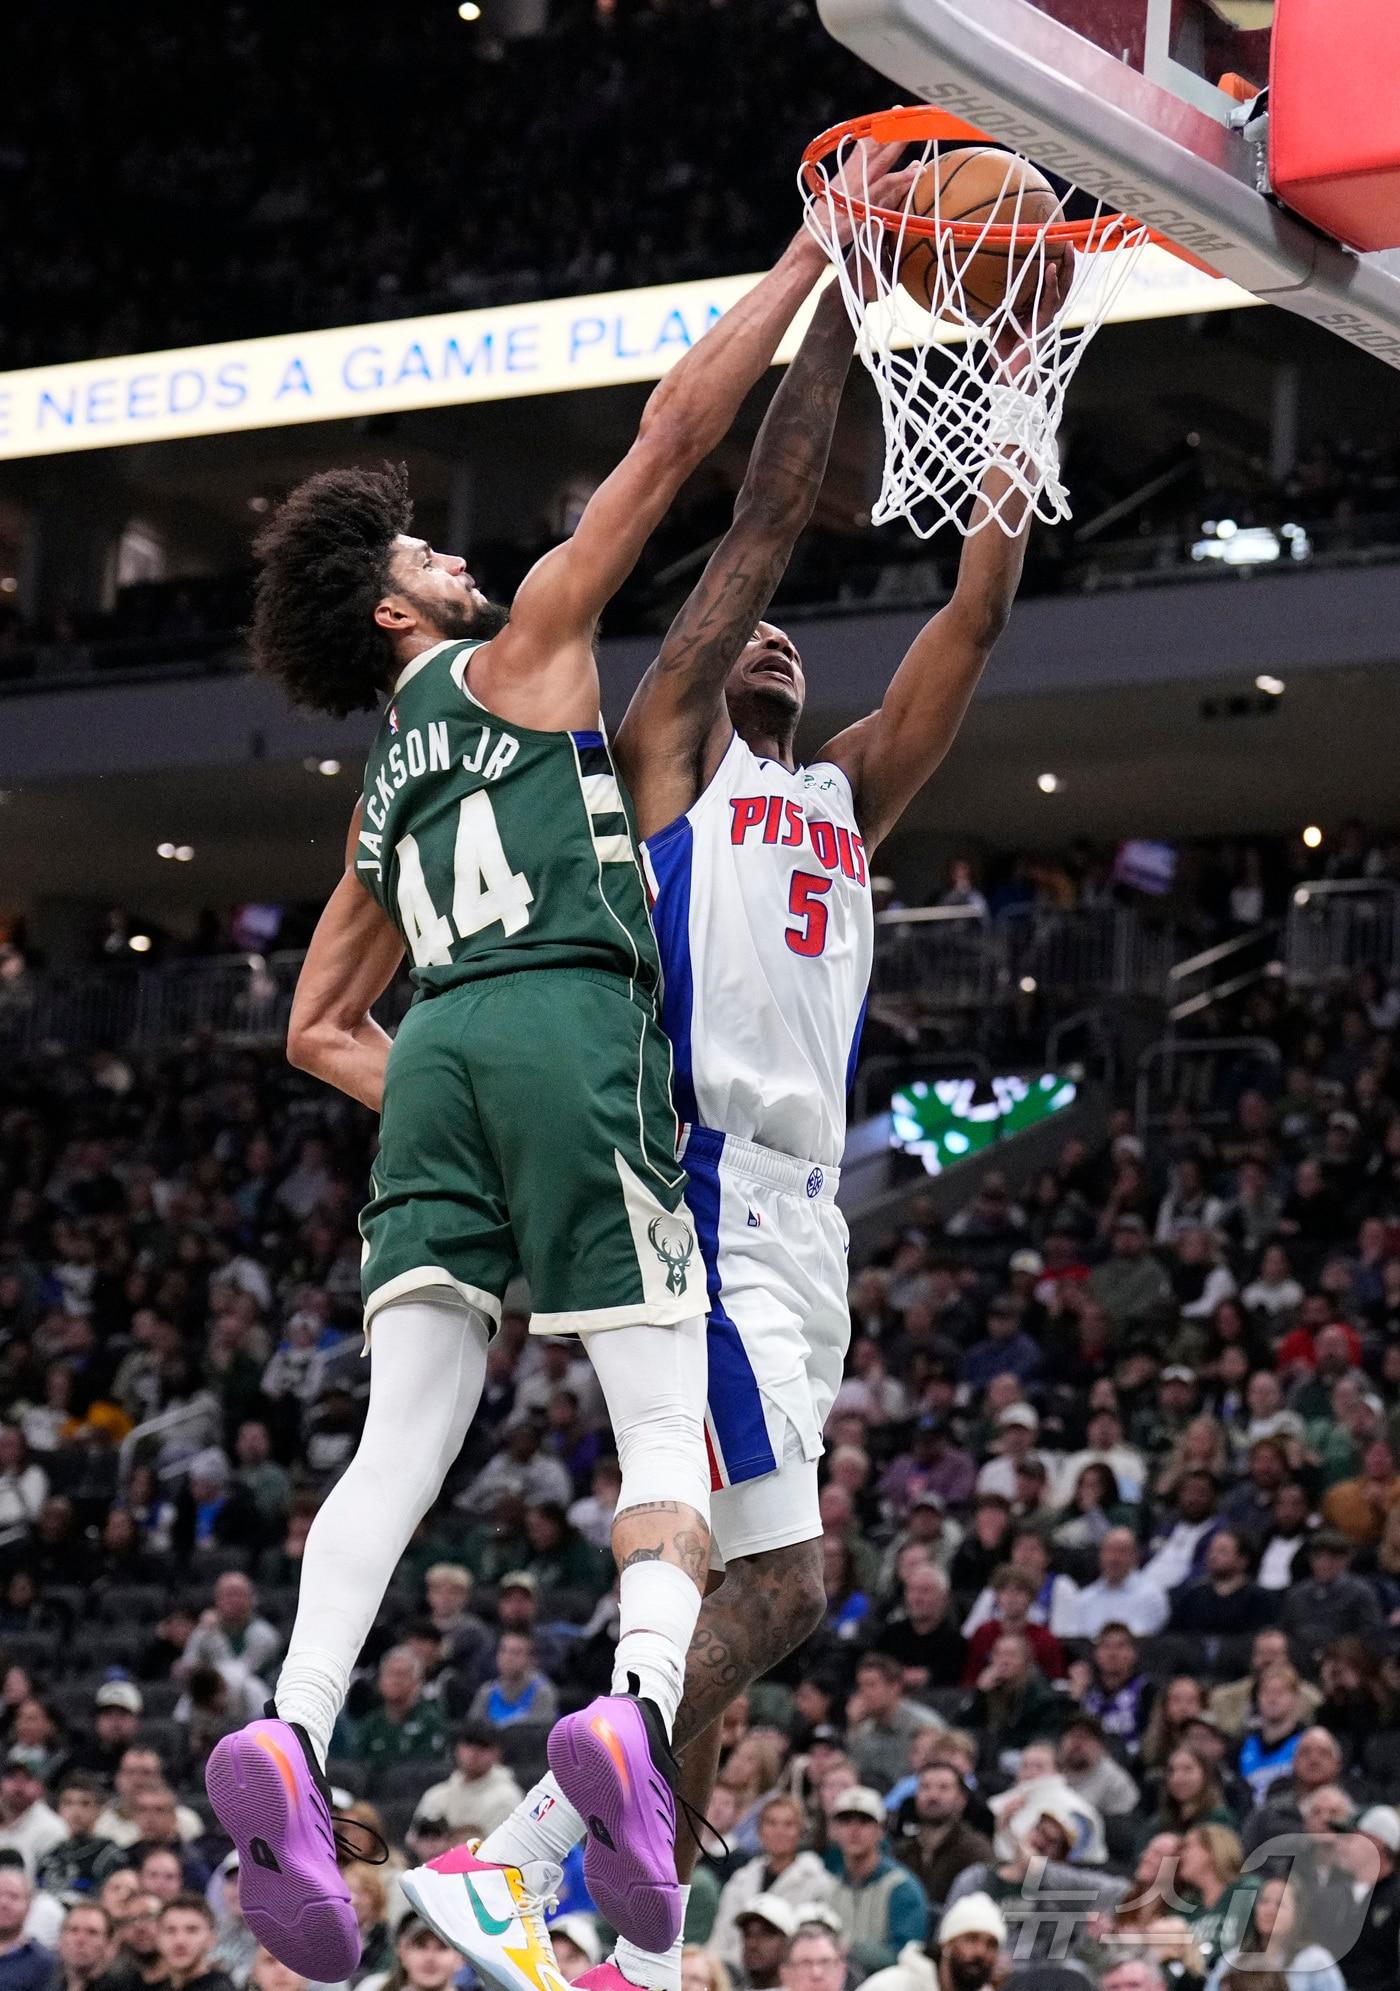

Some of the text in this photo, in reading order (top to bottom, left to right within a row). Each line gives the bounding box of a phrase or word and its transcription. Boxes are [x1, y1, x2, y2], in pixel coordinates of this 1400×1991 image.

[37, 361, 250, 429] NEEDS
[275, 356, 313, 400] A
[343, 324, 540, 394] GAME
[357, 721, 520, 882] JACKSON JR
[395, 788, 534, 968] 44
[784, 869, 833, 958] 5
